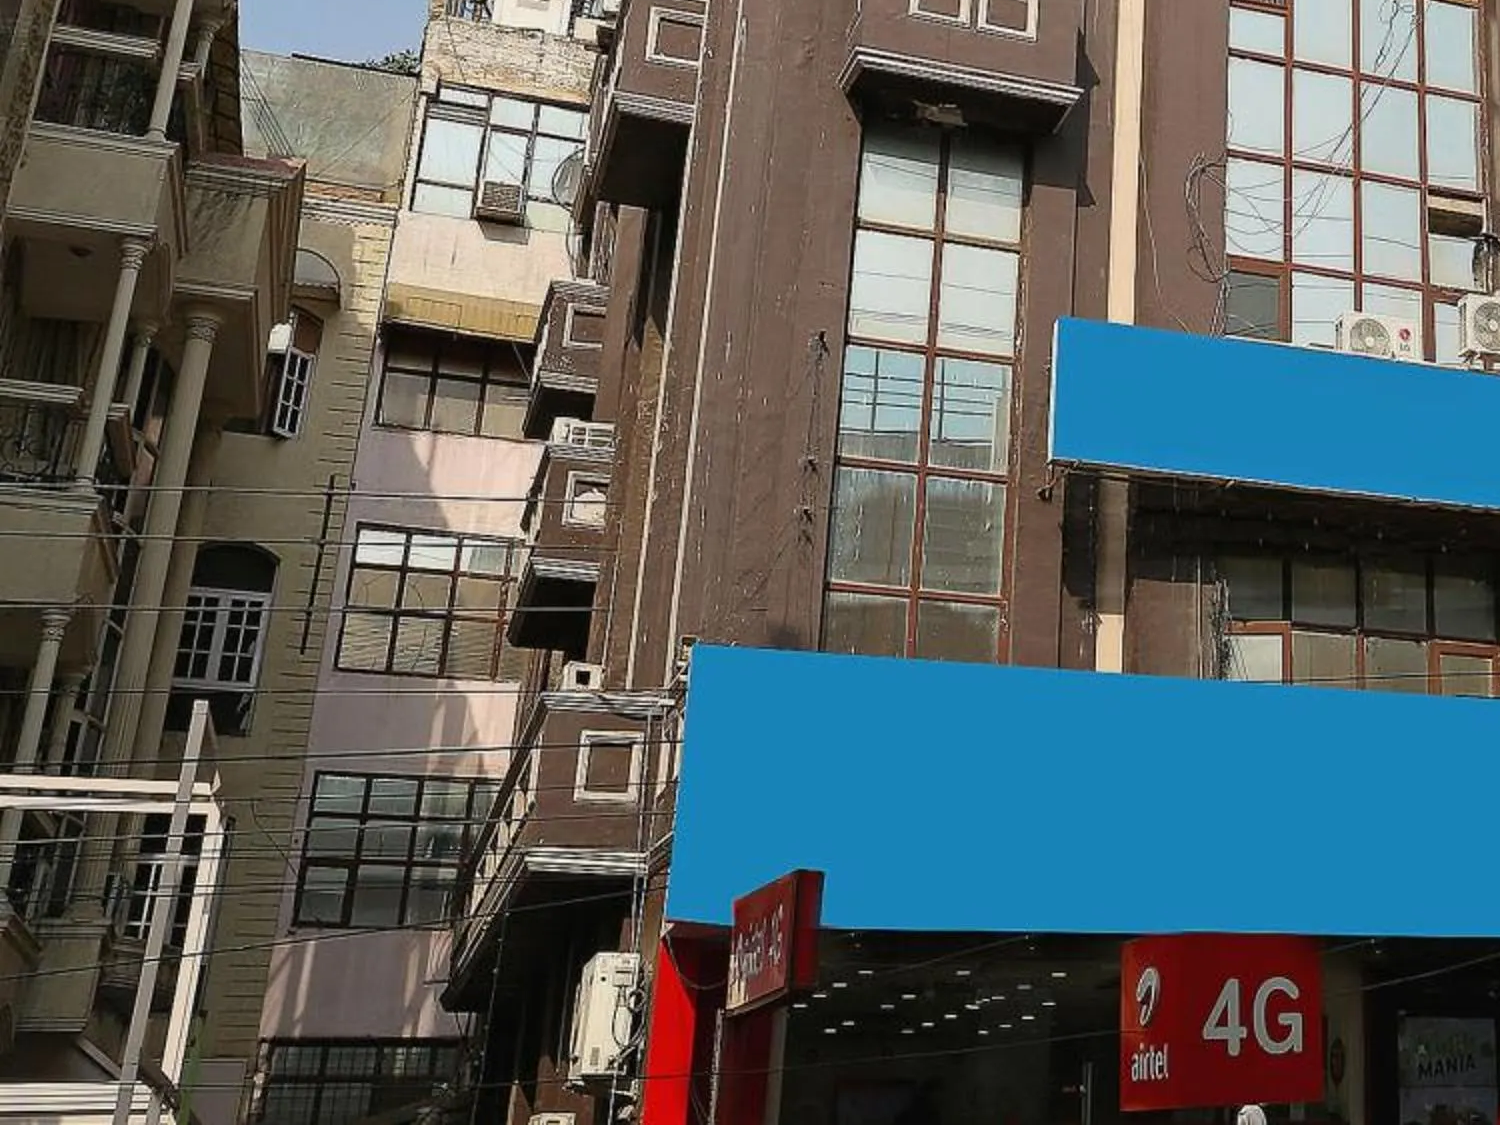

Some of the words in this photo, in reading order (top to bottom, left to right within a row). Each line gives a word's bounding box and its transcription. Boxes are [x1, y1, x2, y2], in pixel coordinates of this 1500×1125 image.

[1202, 975, 1303, 1057] 4G
[1130, 1042, 1170, 1083] airtel
[1418, 1053, 1476, 1081] MANIA
